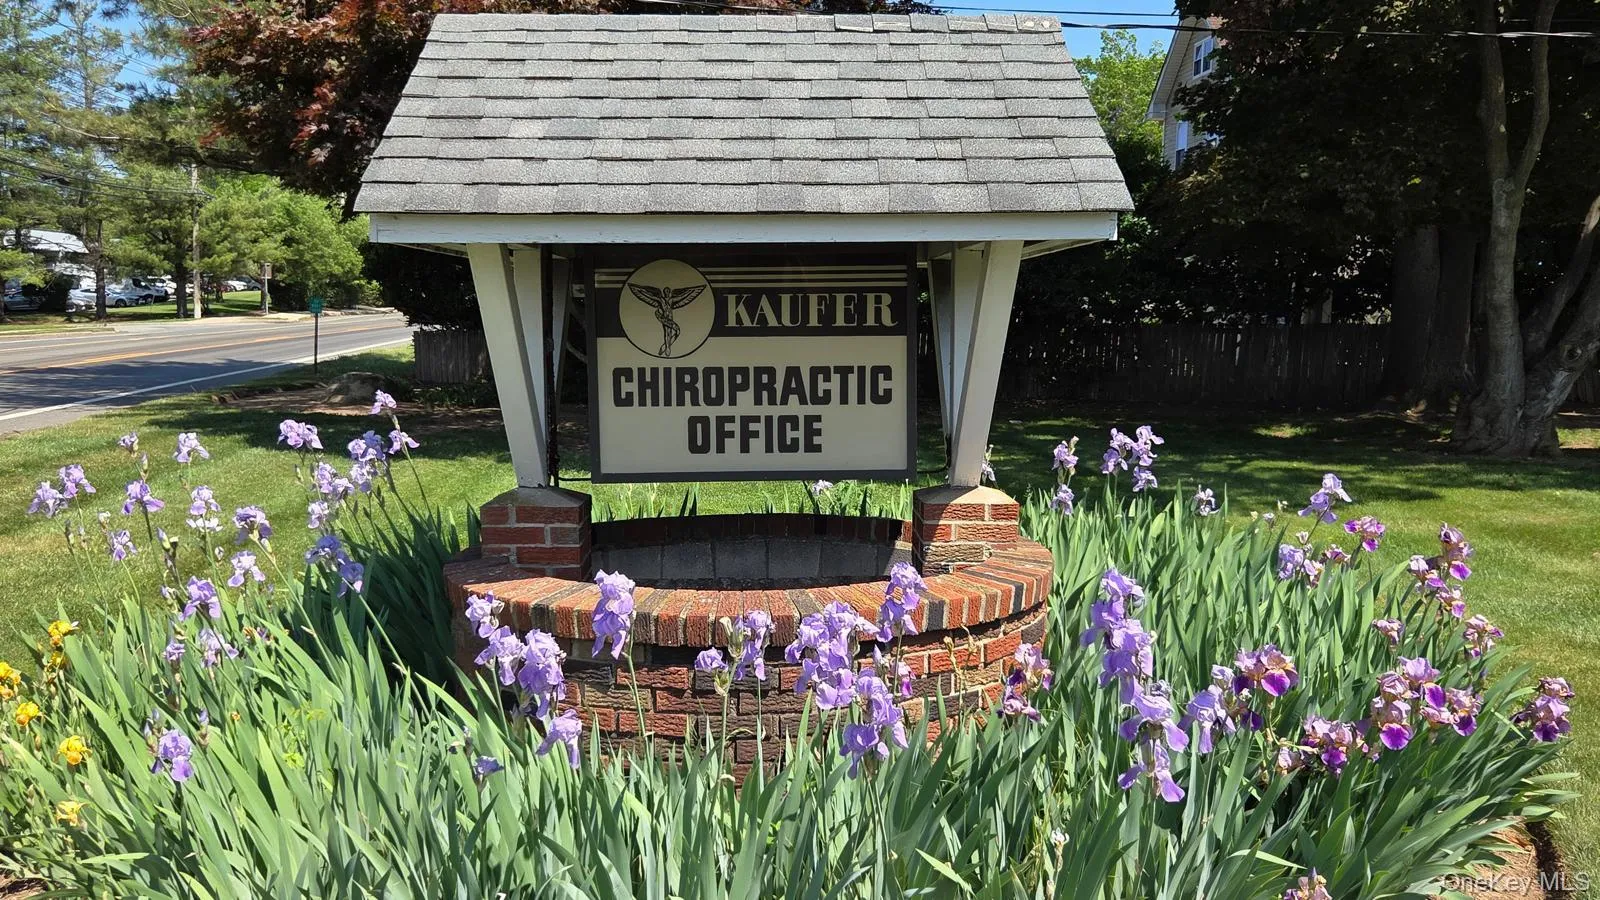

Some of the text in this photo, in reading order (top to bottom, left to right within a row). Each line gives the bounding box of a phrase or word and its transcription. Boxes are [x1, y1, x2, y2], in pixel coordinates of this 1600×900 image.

[723, 292, 898, 327] KAUFER
[612, 365, 892, 407] CHIROPRACTIC
[687, 414, 822, 454] OFFICE
